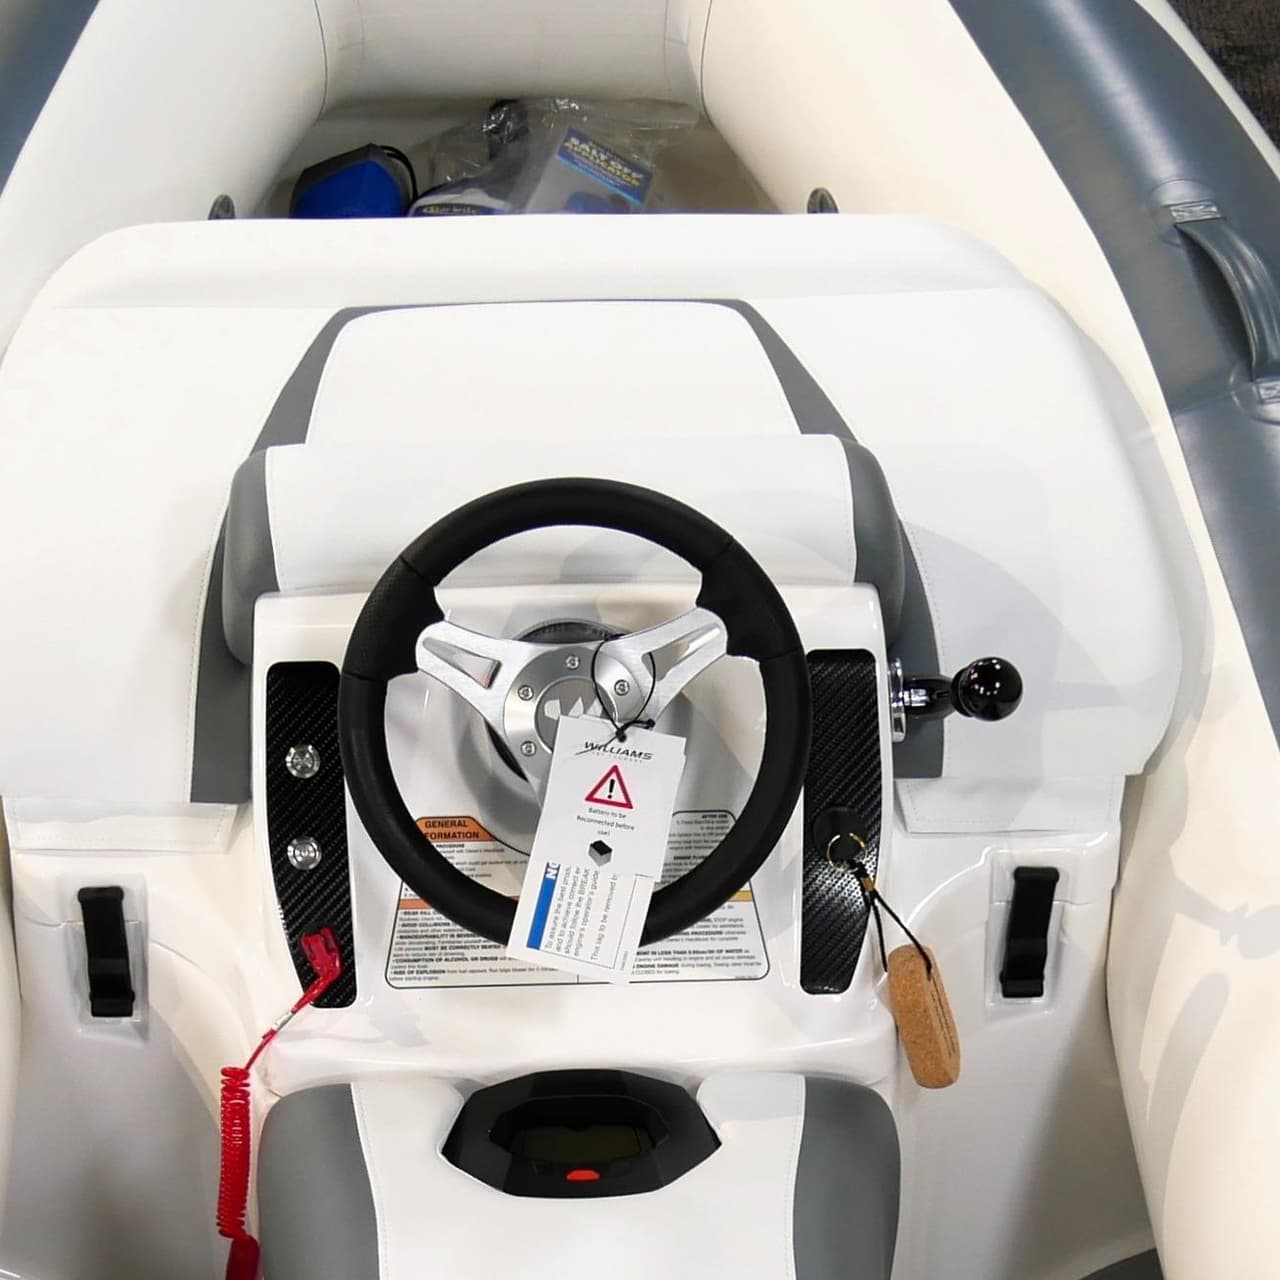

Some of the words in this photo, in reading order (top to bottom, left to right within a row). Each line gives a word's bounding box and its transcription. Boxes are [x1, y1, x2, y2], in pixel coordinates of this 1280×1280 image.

[580, 741, 653, 760] WILLIAMS
[589, 807, 610, 817] Battery
[424, 820, 469, 828] GENERAL
[577, 815, 615, 827] Reconnected
[615, 821, 635, 830] before
[424, 831, 479, 840] FORMATION
[557, 885, 566, 901] best
[602, 881, 616, 913] removed
[553, 902, 562, 914] the
[554, 937, 563, 952] and
[560, 900, 573, 929] achieve
[567, 874, 579, 900] correct
[548, 915, 559, 939] assure
[563, 929, 575, 954] should
[569, 908, 580, 929] follow
[575, 895, 584, 908] the
[594, 931, 605, 945] tag
[589, 945, 600, 961] This
